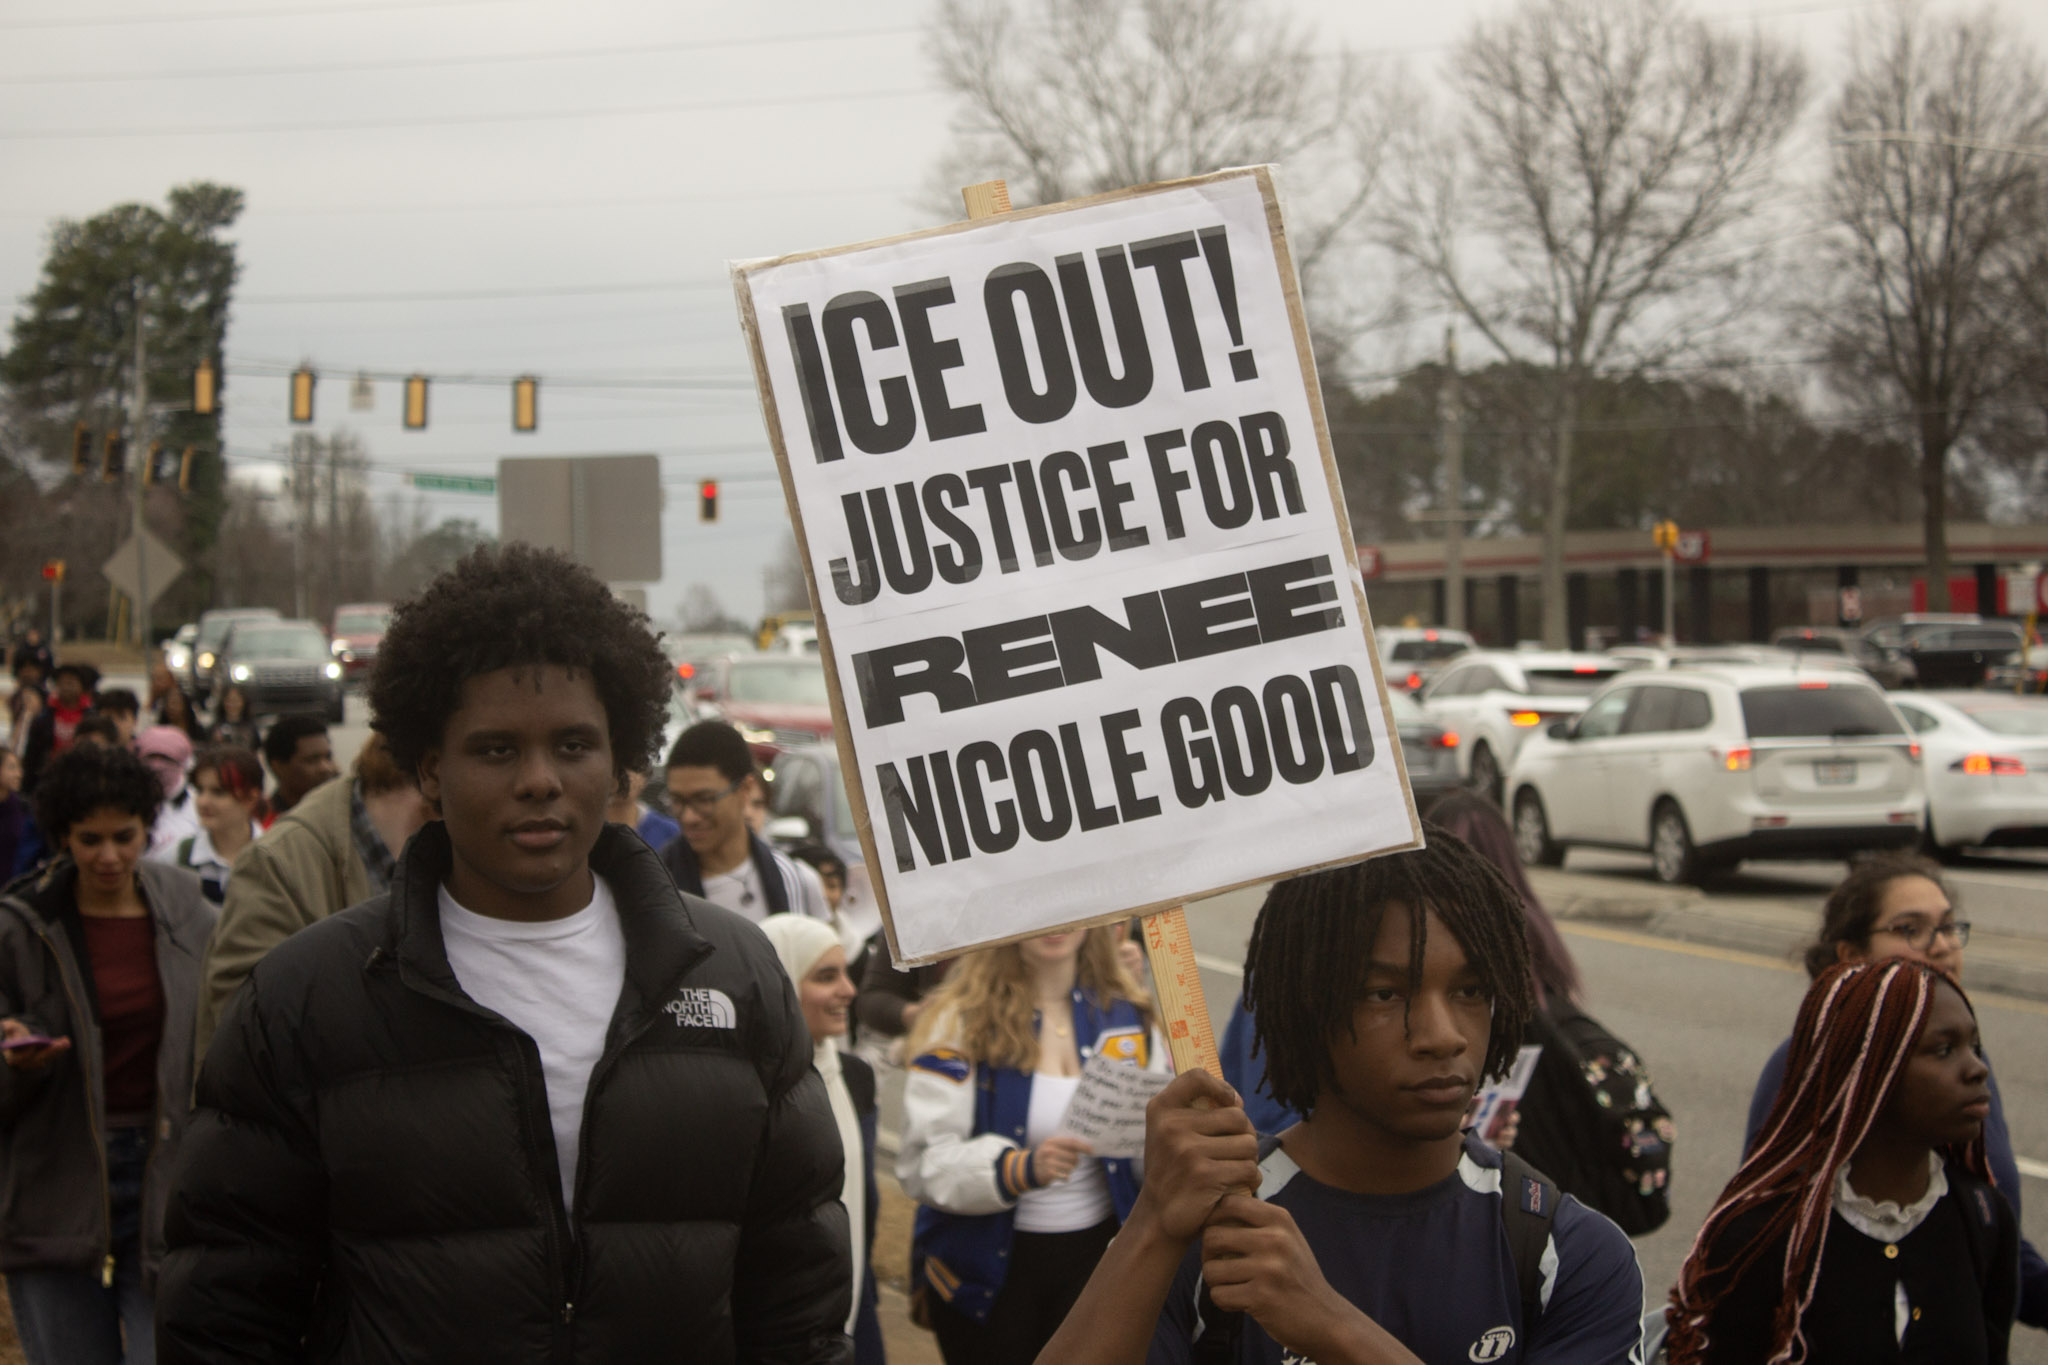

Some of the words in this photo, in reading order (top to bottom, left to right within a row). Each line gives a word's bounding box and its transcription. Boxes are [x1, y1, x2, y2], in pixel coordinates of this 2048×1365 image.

[780, 277, 987, 464] ICE
[983, 224, 1260, 425] OUT!
[828, 440, 1150, 607] JUSTICE
[1144, 410, 1308, 541] FOR
[851, 554, 1346, 730] RENEE
[875, 708, 1163, 874] NICOLE
[1159, 664, 1376, 806] GOOD
[1169, 942, 1180, 955] 25
[1176, 973, 1186, 987] 26
[680, 988, 709, 1001] THE
[1184, 1004, 1194, 1017] 27
[676, 1014, 713, 1027] FACE
[1191, 1035, 1202, 1049] 28
